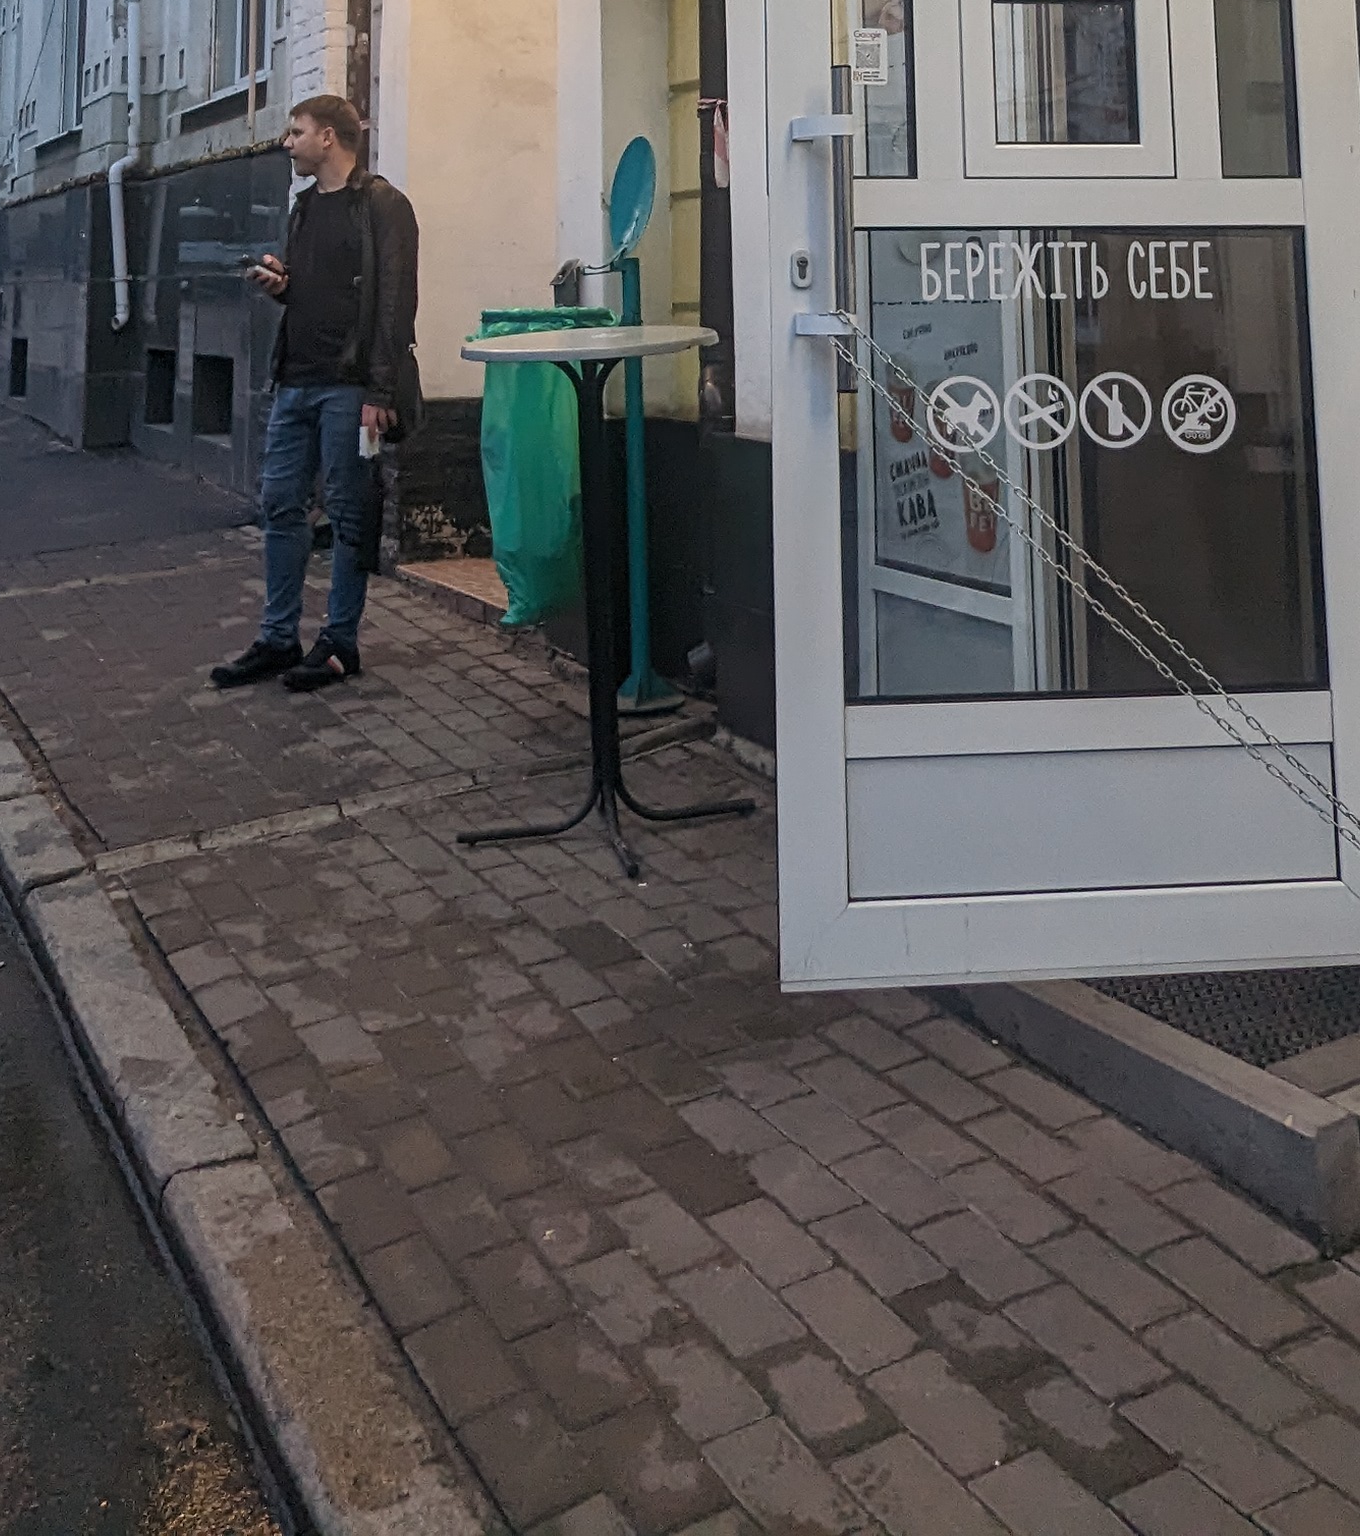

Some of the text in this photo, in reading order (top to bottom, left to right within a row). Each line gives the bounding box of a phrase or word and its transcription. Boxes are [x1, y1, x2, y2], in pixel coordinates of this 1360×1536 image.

[920, 240, 1213, 302] БЕРЕЖІТЬ СЕБЕ
[897, 489, 938, 526] КАВА
